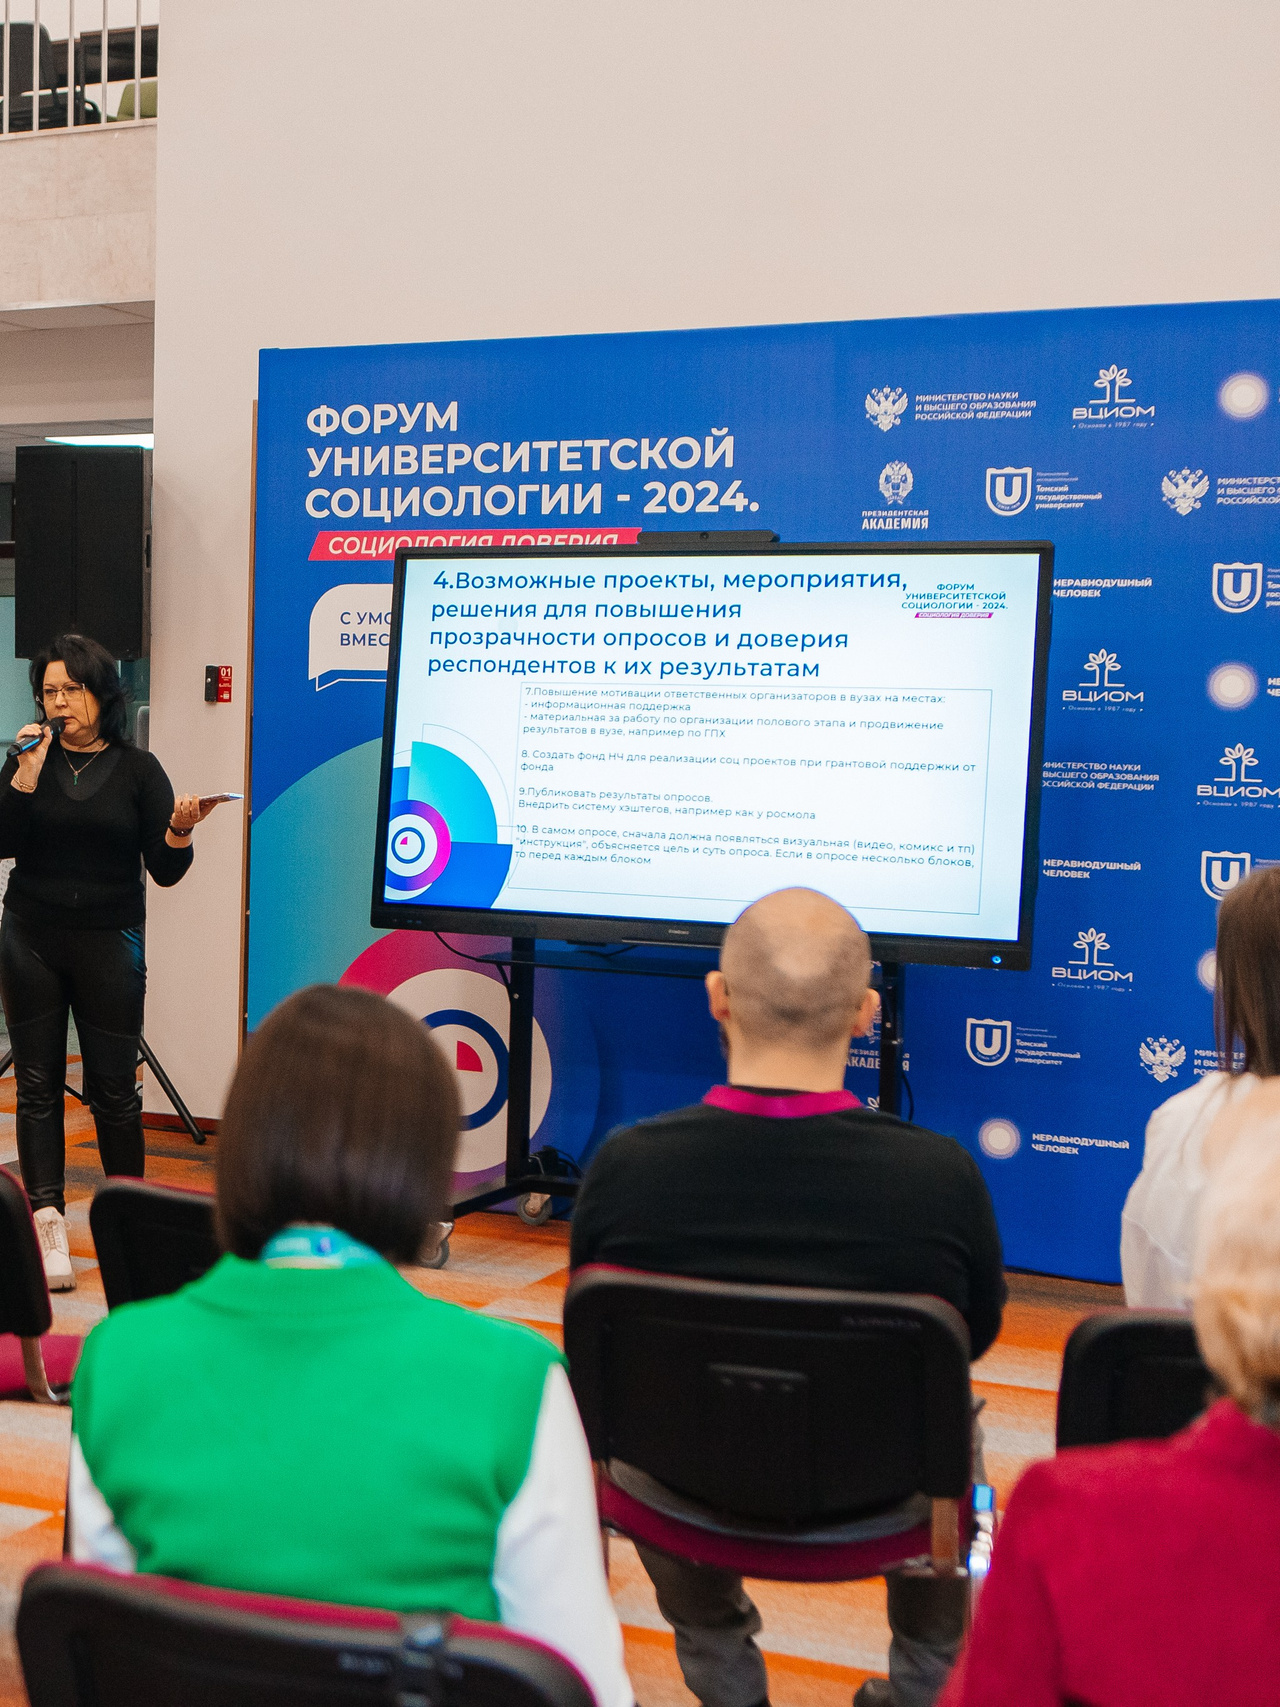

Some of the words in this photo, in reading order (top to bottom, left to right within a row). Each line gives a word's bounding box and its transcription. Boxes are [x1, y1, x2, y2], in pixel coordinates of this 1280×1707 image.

[915, 393, 986, 402] МИНИСТЕРСТВО
[988, 392, 1019, 400] НАУКИ
[915, 404, 922, 412] И
[923, 403, 968, 411] ВЫСШЕГО
[969, 400, 1037, 410] ОБРАЗОВАНИЯ
[1072, 405, 1155, 420] ВЦИОМ
[306, 401, 458, 437] ФОРУМ
[915, 410, 974, 420] РОССИЙСКОЙ
[976, 410, 1032, 420] ФЕДЕРАЦИИ
[306, 427, 734, 478] УНИВЕРСИТЕТСКОЙ
[996, 476, 1022, 504] U
[1036, 484, 1069, 492] Томский
[1226, 486, 1276, 495] ВЫСШЕГО
[305, 483, 602, 522] СОЦИОЛОГИИ
[617, 494, 631, 502] -
[643, 480, 760, 514] 2024.
[862, 518, 928, 530] АКАДЕМИЯ
[433, 570, 596, 589] 4.Возможные
[604, 574, 715, 593] проекты,
[723, 573, 907, 593] мероприятия,
[936, 583, 975, 591] ФОРУМ
[1054, 577, 1152, 588] НЕРАВНОДУШНЫЙ
[1222, 572, 1252, 602] U
[905, 591, 1006, 600] УНИВЕРСИТЕТСКОЙ
[1053, 589, 1101, 597] ЧЕЛОВЕК
[901, 602, 973, 610] СОЦИОЛОГИИ
[340, 611, 351, 625] С
[432, 604, 537, 622] решения
[543, 604, 587, 620] для
[595, 604, 742, 618] повышения
[430, 631, 595, 650] прозрачности
[603, 632, 706, 651] опросов
[715, 633, 729, 647] и
[736, 633, 848, 652] доверия
[221, 668, 230, 676] 01
[428, 658, 596, 677] респондентов
[604, 660, 616, 674] к
[624, 661, 652, 675] их
[660, 661, 819, 680] результатам
[525, 687, 598, 697] 7.Повышение
[601, 690, 661, 698] мотивации
[664, 691, 747, 699] ответственных
[750, 692, 837, 702] организаторов
[840, 694, 846, 702] в
[850, 694, 881, 704] вузах
[885, 695, 899, 703] на
[902, 695, 945, 703] местах:
[1062, 690, 1144, 703] ВЦИОМ
[531, 700, 626, 710] информационная
[629, 703, 691, 712] поддержка
[530, 713, 606, 722] материальная
[623, 713, 660, 725] работу
[663, 716, 677, 724] по
[679, 716, 754, 726] организации
[757, 718, 811, 727] полового
[814, 720, 846, 728] этапа
[860, 721, 944, 730] продвижение
[523, 726, 587, 735] результатов
[590, 727, 596, 735] в
[599, 728, 625, 737] вузе,
[628, 728, 685, 738] например
[704, 728, 726, 738] ГПХ
[520, 762, 554, 772] фонда
[521, 749, 530, 758] 8.
[532, 749, 575, 760] Создать
[577, 752, 606, 761] фонд
[608, 752, 624, 760] НЧ
[626, 754, 646, 762] для
[649, 754, 717, 764] реализации
[719, 757, 740, 765] соц
[743, 757, 796, 766] проектов
[800, 759, 822, 768] при
[825, 760, 887, 769] грантовой
[890, 762, 959, 772] поддержки
[962, 764, 976, 772] от
[1043, 771, 1088, 779] ВЫСШЕГО
[1089, 772, 1160, 781] ОБРАЗОВАНИЯ
[1096, 782, 1154, 791] ФЕДЕРАЦИИ
[1196, 784, 1280, 798] ВЦИОМ
[518, 786, 597, 798] 9.Публиковать
[599, 791, 661, 801] результаты
[663, 794, 713, 803] опросов.
[518, 799, 570, 810] Внедрить
[572, 803, 616, 814] систему
[619, 805, 672, 814] хэштегов,
[675, 807, 732, 817] например
[735, 809, 754, 817] как
[757, 811, 763, 819] у
[766, 810, 816, 820] росмола
[532, 824, 539, 834] В
[541, 827, 575, 835] самом
[578, 828, 619, 838] опросе,
[622, 830, 666, 840] сначала
[668, 832, 712, 842] должна
[715, 834, 779, 844] появляться
[782, 838, 850, 848] визуальная
[853, 839, 896, 850] (видео,
[899, 843, 943, 852] комикс
[958, 844, 975, 856] тп)
[529, 851, 561, 861] перед
[564, 853, 608, 862] каждым
[610, 853, 651, 864] блоком
[591, 839, 660, 852] объясняется
[663, 845, 690, 854] цель
[702, 847, 726, 856] суть
[775, 848, 803, 858] Если
[806, 852, 813, 860] в
[815, 852, 858, 862] опросе
[861, 855, 925, 865] несколько
[927, 855, 975, 868] блоков,
[1043, 859, 1141, 871] НЕРАВНОДУШНЫЙ
[1043, 869, 1090, 878] ЧЕЛОВЕК
[1052, 967, 1133, 982] ВЦИОМ
[975, 1027, 1002, 1056] U
[1032, 1133, 1130, 1150] НЕРАВНОДУШНЫЙ
[1031, 1143, 1079, 1155] ЧЕЛОВЕК
